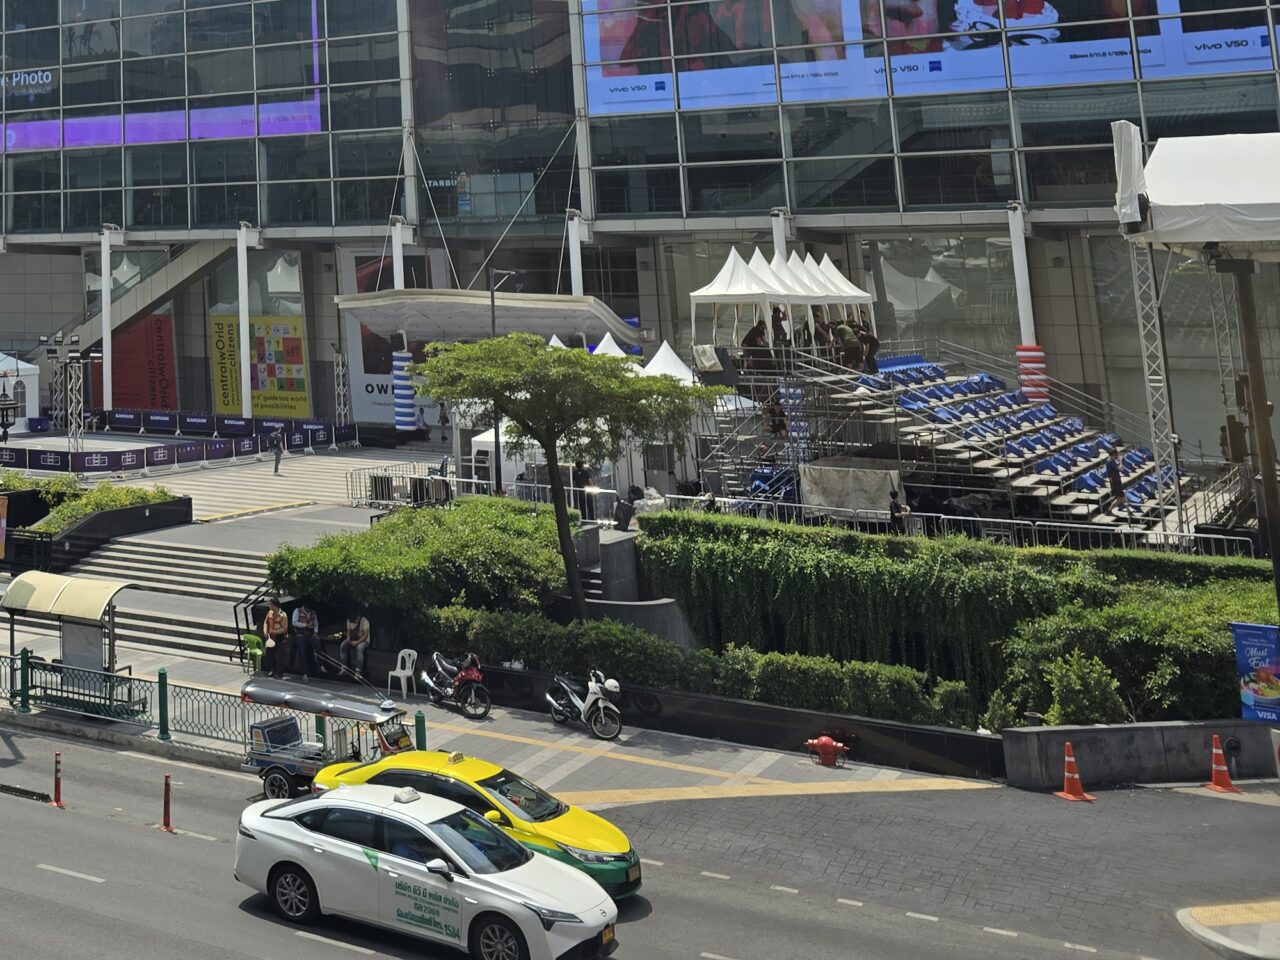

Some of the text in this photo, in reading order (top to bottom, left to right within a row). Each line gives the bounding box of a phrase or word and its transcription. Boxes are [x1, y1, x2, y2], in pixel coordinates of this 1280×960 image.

[1194, 39, 1248, 51] vivo V50
[900, 65, 919, 73] V50
[12, 71, 52, 87] Photo
[227, 323, 237, 368] citizens
[1248, 656, 1271, 669] Eat
[1257, 710, 1278, 720] VISA
